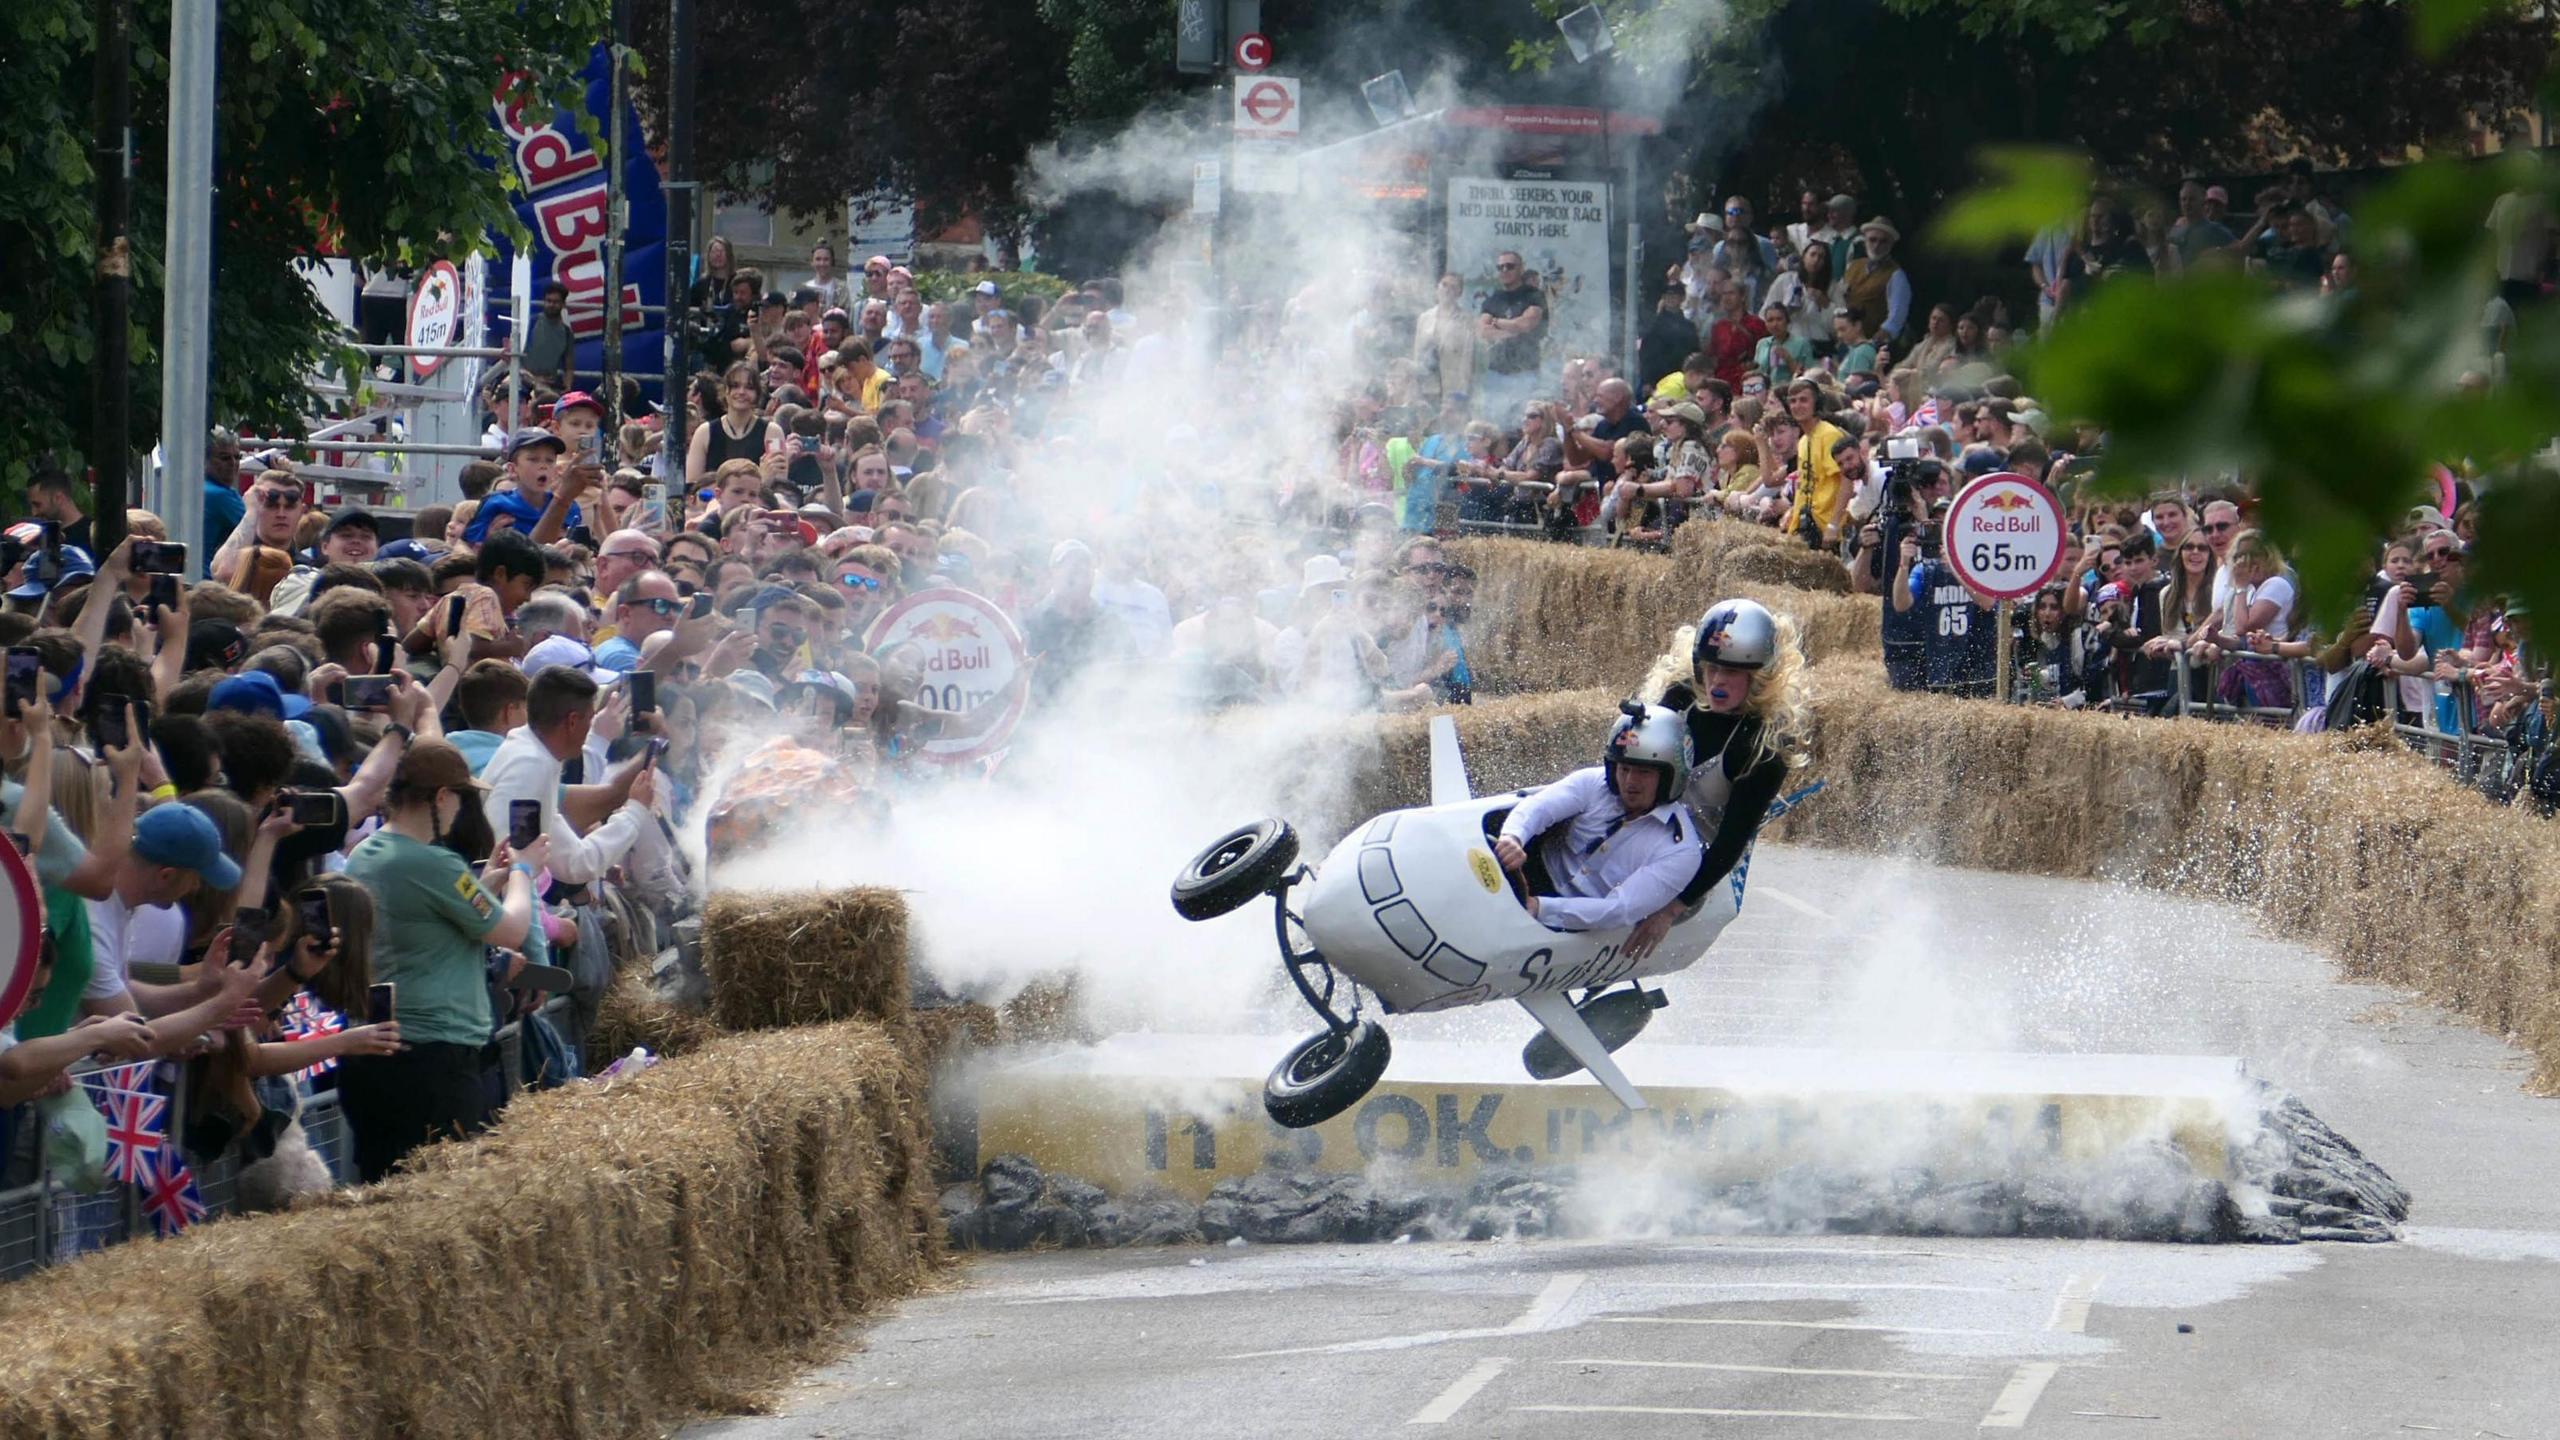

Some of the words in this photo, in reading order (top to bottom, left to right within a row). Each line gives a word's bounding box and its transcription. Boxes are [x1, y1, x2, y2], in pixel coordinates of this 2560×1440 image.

[1239, 37, 1264, 66] C
[1560, 189, 1593, 204] YOUR
[1459, 203, 1482, 217] RED
[1486, 203, 1513, 218] BULL
[1515, 204, 1569, 221] SOAPBOX
[1573, 207, 1602, 222] RACE
[1494, 222, 1534, 237] STARTS
[418, 322, 447, 346] 415m
[1972, 515, 2005, 532] Red
[2008, 515, 2040, 533] Bull
[1971, 543, 2037, 572] 65m
[1938, 606, 1968, 636] 65
[947, 646, 990, 672] Bull
